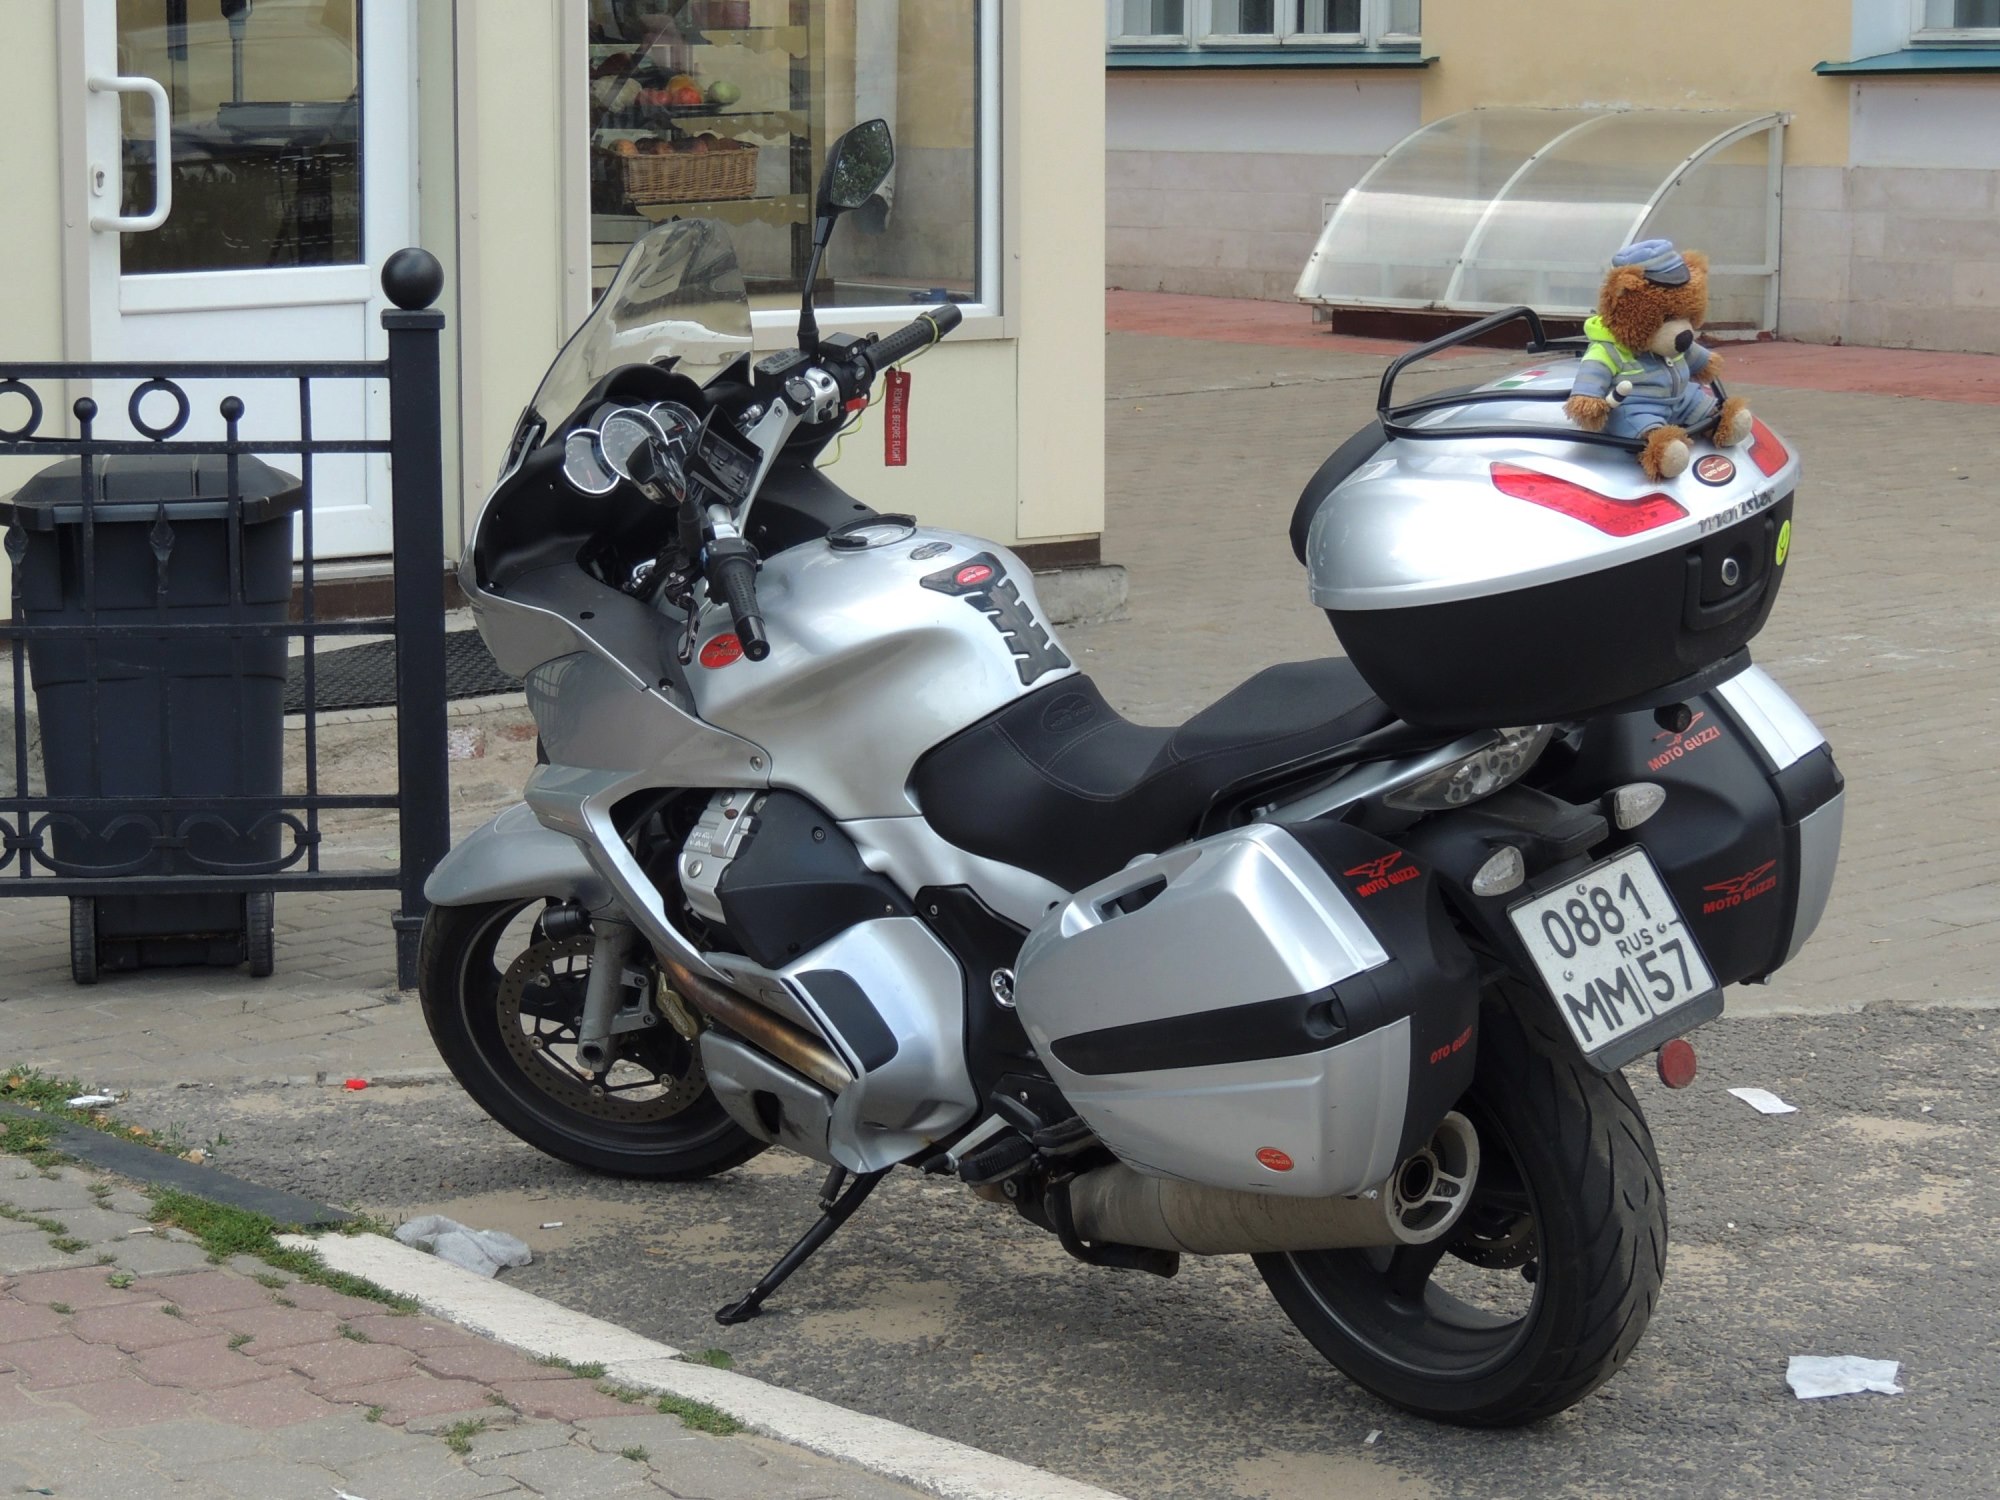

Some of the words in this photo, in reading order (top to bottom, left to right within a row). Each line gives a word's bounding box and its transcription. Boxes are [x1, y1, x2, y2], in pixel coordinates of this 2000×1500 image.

[891, 388, 903, 413] REMOVE
[891, 414, 901, 438] BEFORE
[891, 440, 901, 462] FLIGHT
[1648, 746, 1684, 772] MOTO
[1684, 725, 1721, 751] GUZZI
[1356, 877, 1389, 897] MOTO
[1388, 866, 1420, 885] GUZZI
[1703, 894, 1740, 914] MOTO
[1743, 875, 1776, 900] GUZZI
[1541, 872, 1651, 959] 0881
[1615, 927, 1654, 958] RUS
[1563, 966, 1646, 1043] MM
[1636, 937, 1693, 1002] 57
